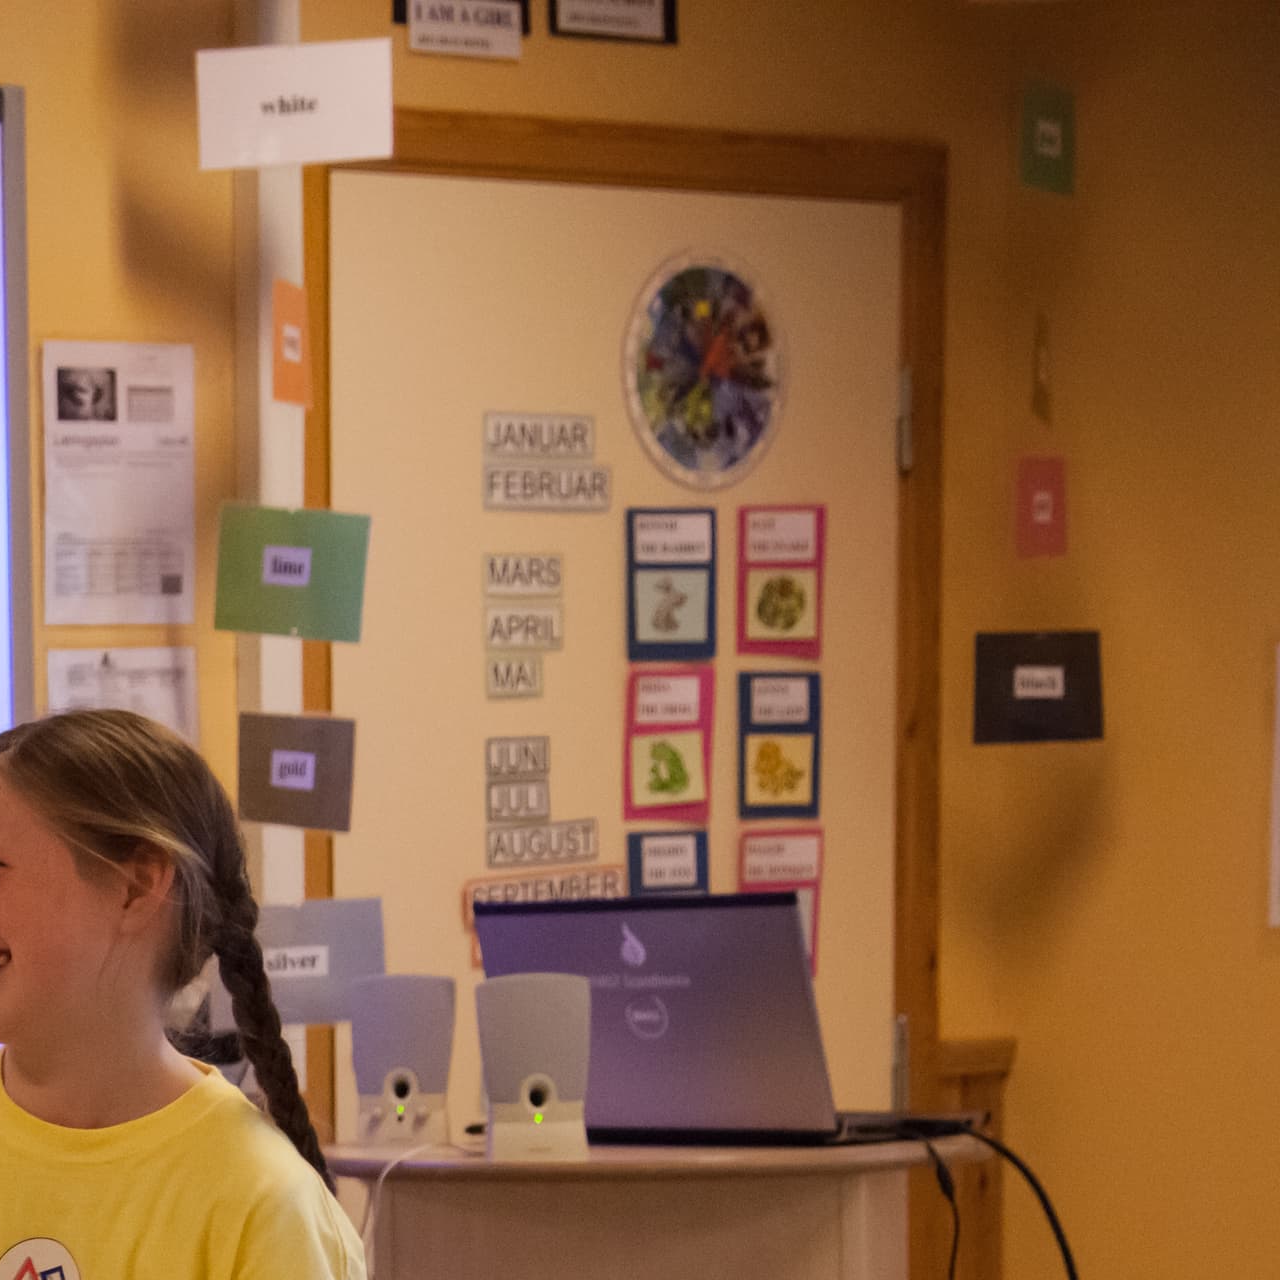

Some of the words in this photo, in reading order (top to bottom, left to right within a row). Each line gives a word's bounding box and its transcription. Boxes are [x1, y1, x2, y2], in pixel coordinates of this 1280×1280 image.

[260, 94, 318, 115] white
[488, 422, 588, 450] JANUAR
[488, 470, 608, 500] FEBRUAR
[489, 558, 561, 587] MARS
[490, 616, 560, 642] APRIL
[492, 826, 593, 862] AUGUST
[266, 953, 320, 971] silver
